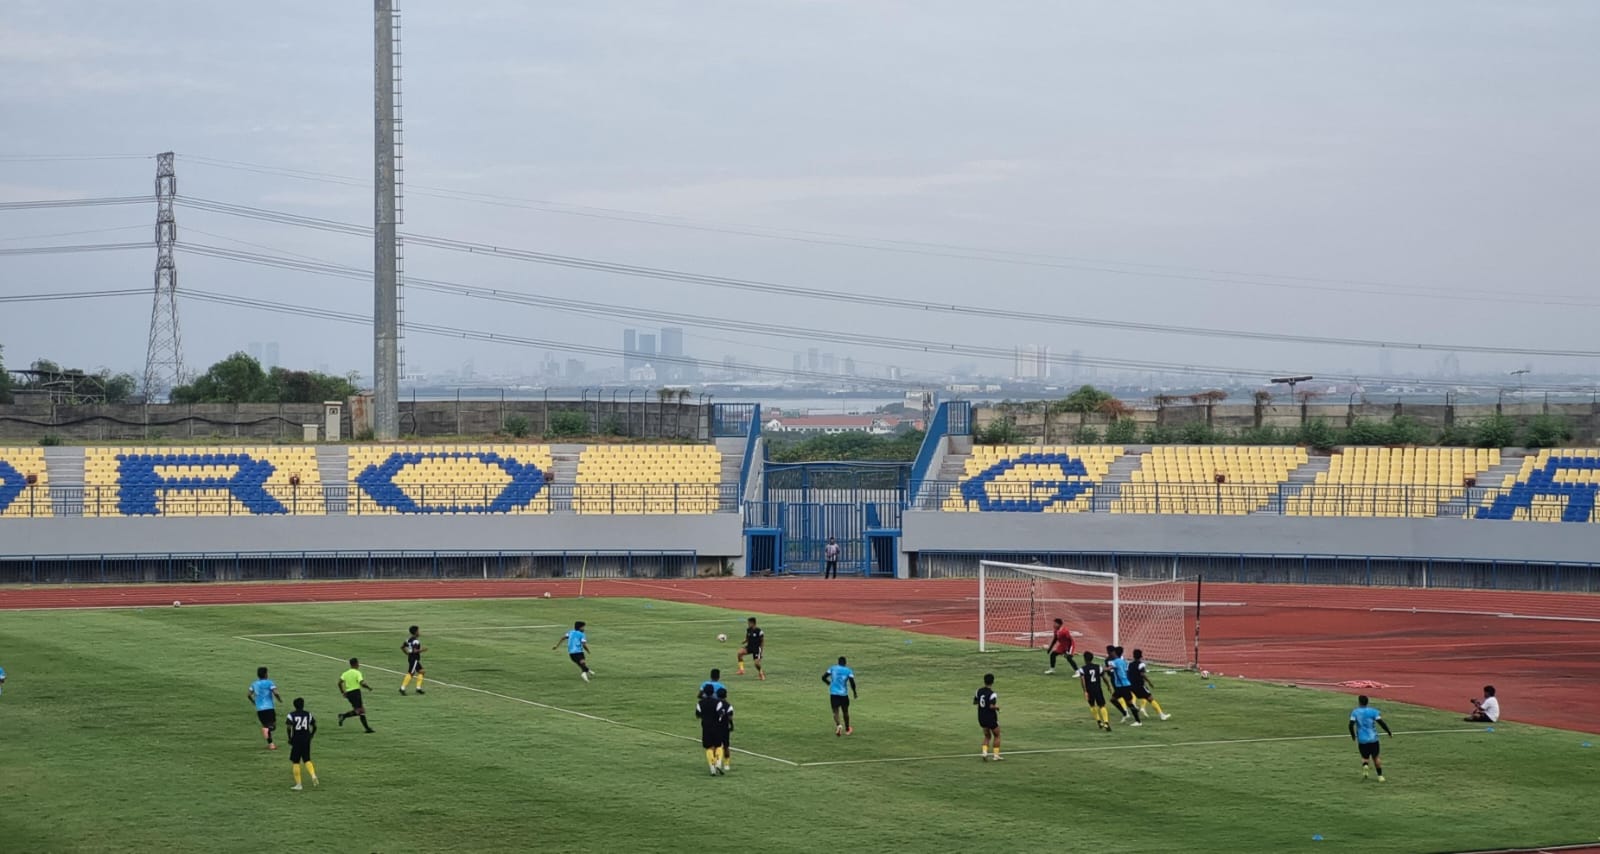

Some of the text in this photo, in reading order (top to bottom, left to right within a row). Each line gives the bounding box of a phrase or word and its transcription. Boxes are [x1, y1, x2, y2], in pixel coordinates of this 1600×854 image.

[1089, 669, 1097, 682] 2
[980, 694, 986, 708] 6
[294, 716, 308, 730] 24
